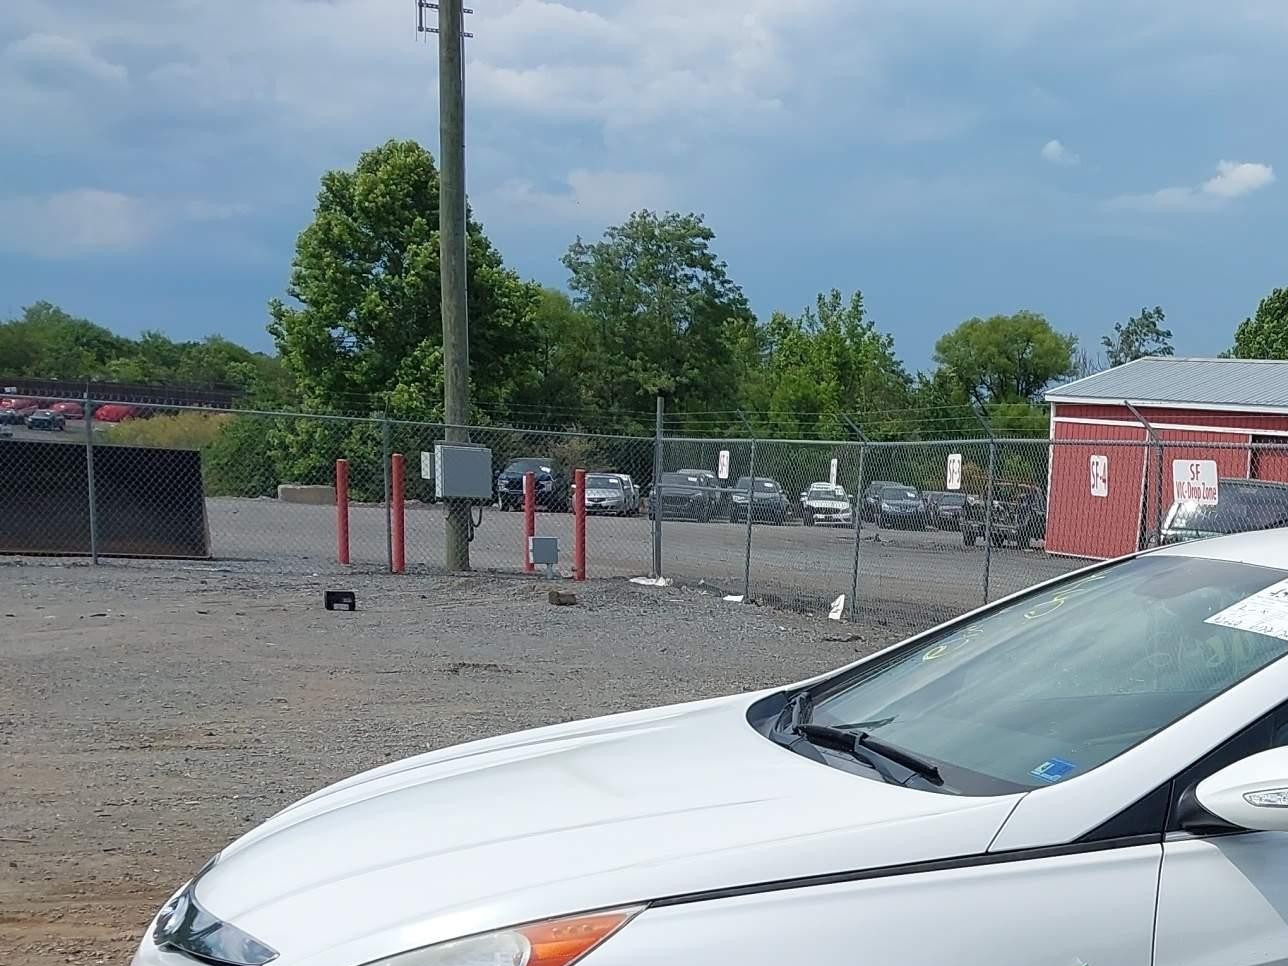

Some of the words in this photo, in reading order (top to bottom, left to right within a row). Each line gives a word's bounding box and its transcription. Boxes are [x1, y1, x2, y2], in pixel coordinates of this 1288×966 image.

[1091, 461, 1107, 489] SF-4
[1190, 463, 1200, 480] SF
[1202, 482, 1217, 500] Zone
